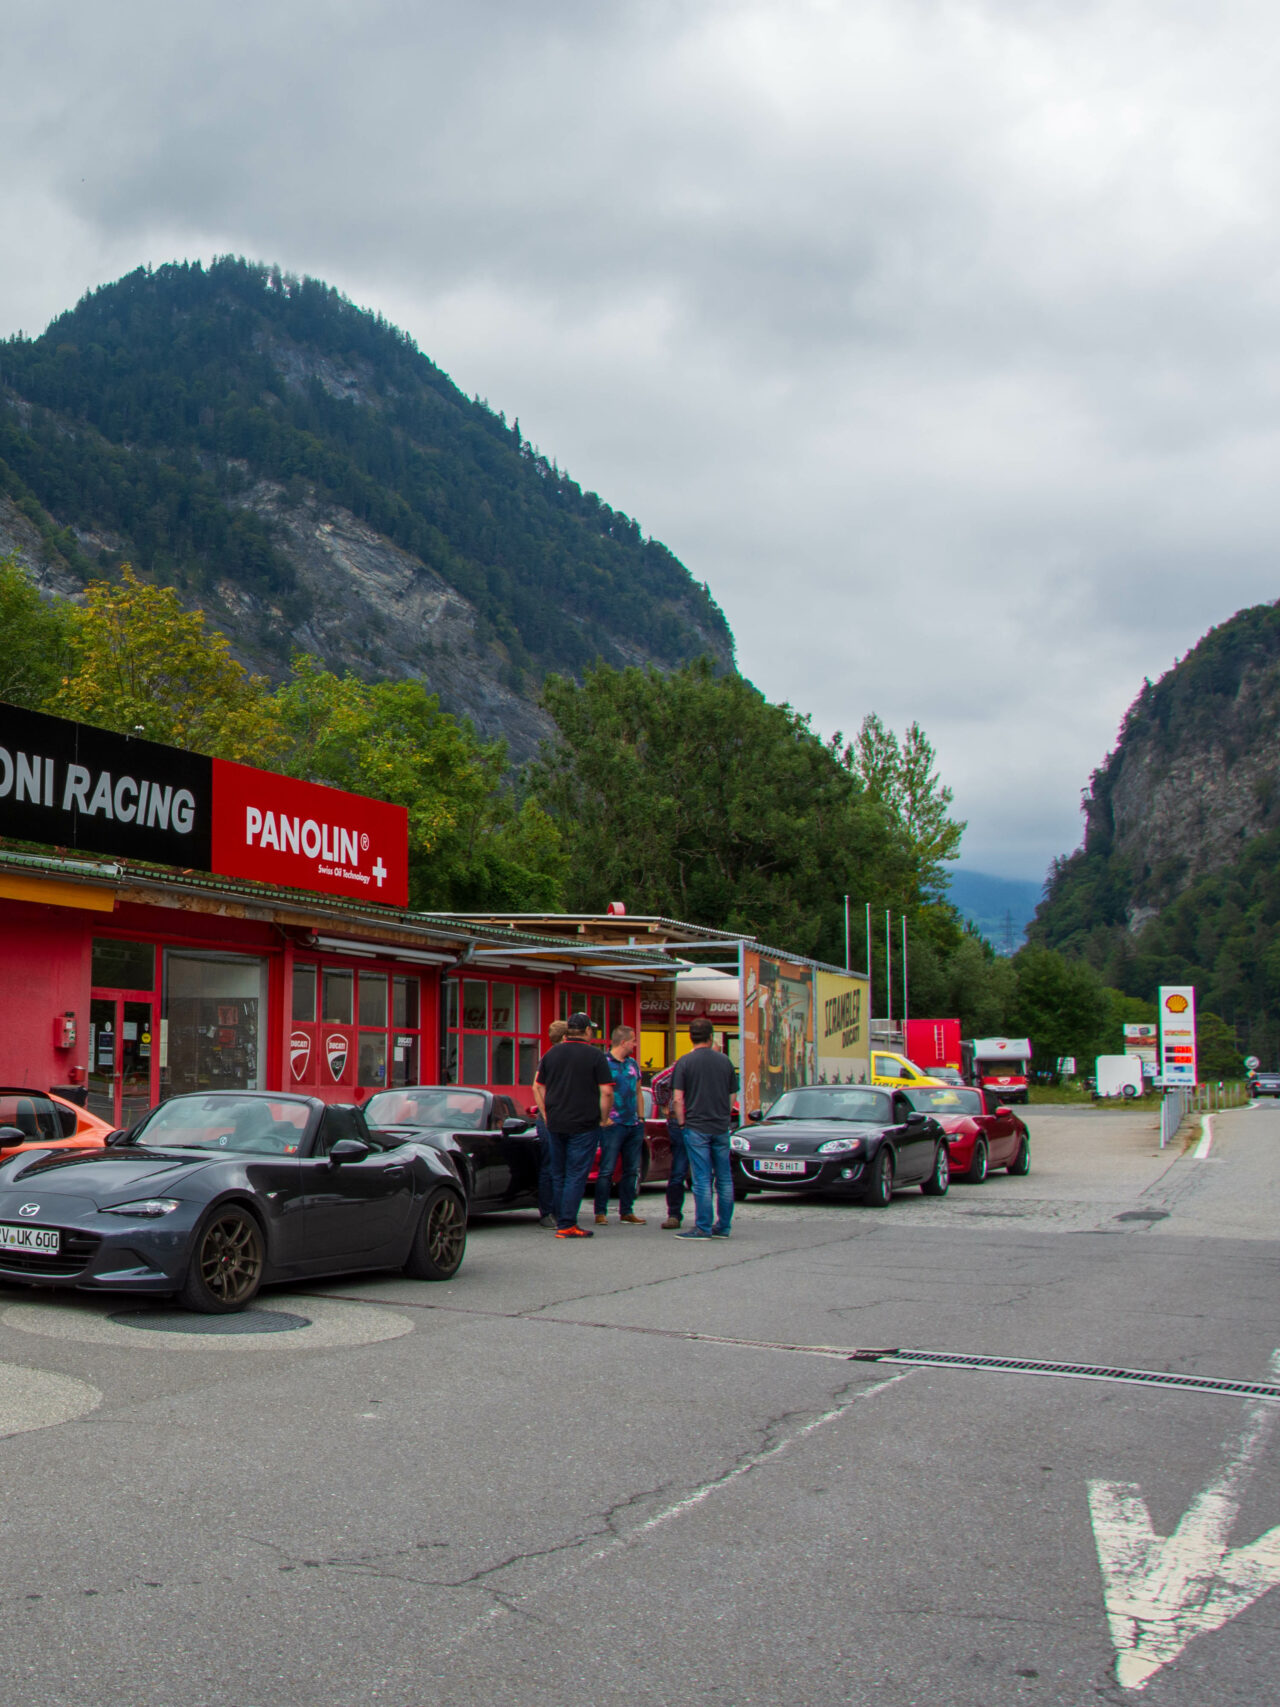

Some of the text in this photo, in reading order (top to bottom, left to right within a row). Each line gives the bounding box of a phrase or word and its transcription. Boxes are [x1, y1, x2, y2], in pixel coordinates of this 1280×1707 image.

[62, 763, 196, 834] RACING
[317, 864, 371, 885] Swiss Oil Technology
[710, 1002, 739, 1012] DUCA
[825, 988, 861, 1038] SCRAMBLER
[291, 1039, 308, 1048] DUCATI
[328, 1042, 346, 1050] DUCATI
[841, 1025, 860, 1049] DUCATI
[17, 1230, 33, 1246] UK
[35, 1231, 58, 1249] 600
